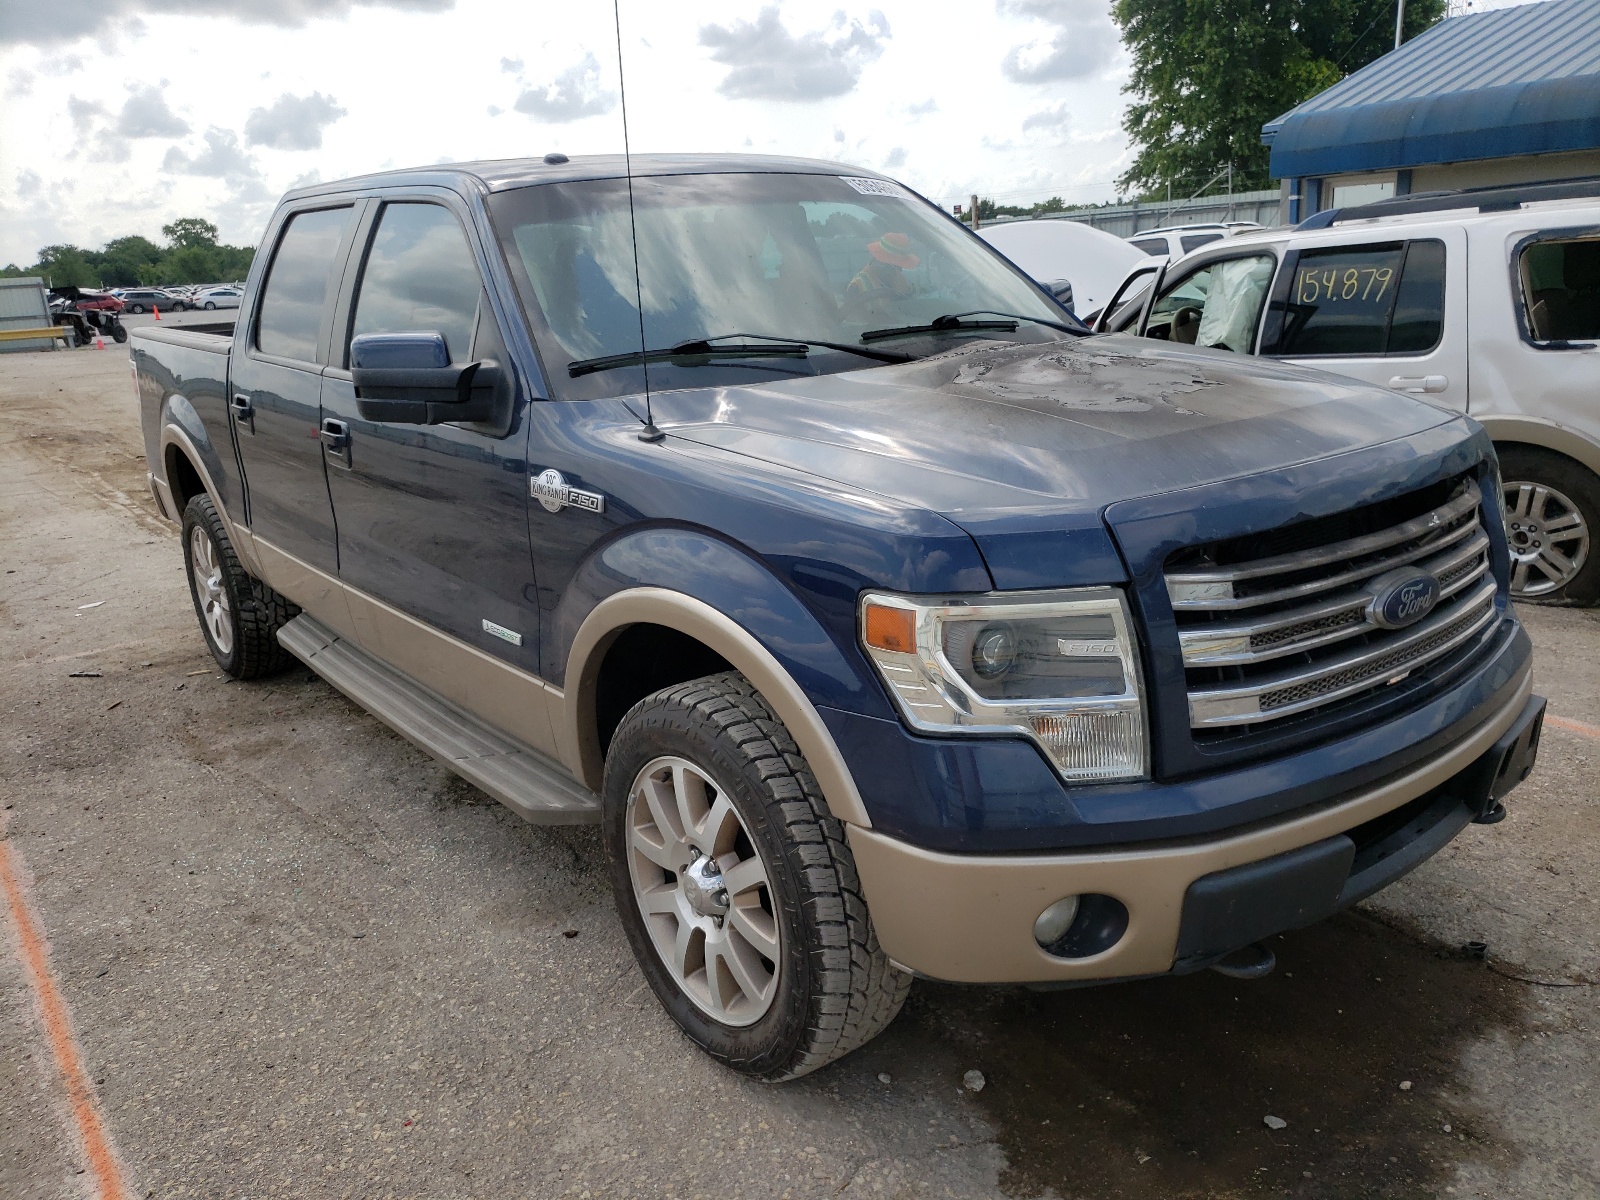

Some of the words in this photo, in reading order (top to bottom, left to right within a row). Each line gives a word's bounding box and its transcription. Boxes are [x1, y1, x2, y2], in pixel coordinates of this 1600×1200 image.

[1297, 267, 1393, 306] 154.879
[532, 481, 547, 496] KING
[547, 487, 567, 502] RANCH
[569, 492, 599, 509] F-150
[1398, 582, 1432, 619] Ford
